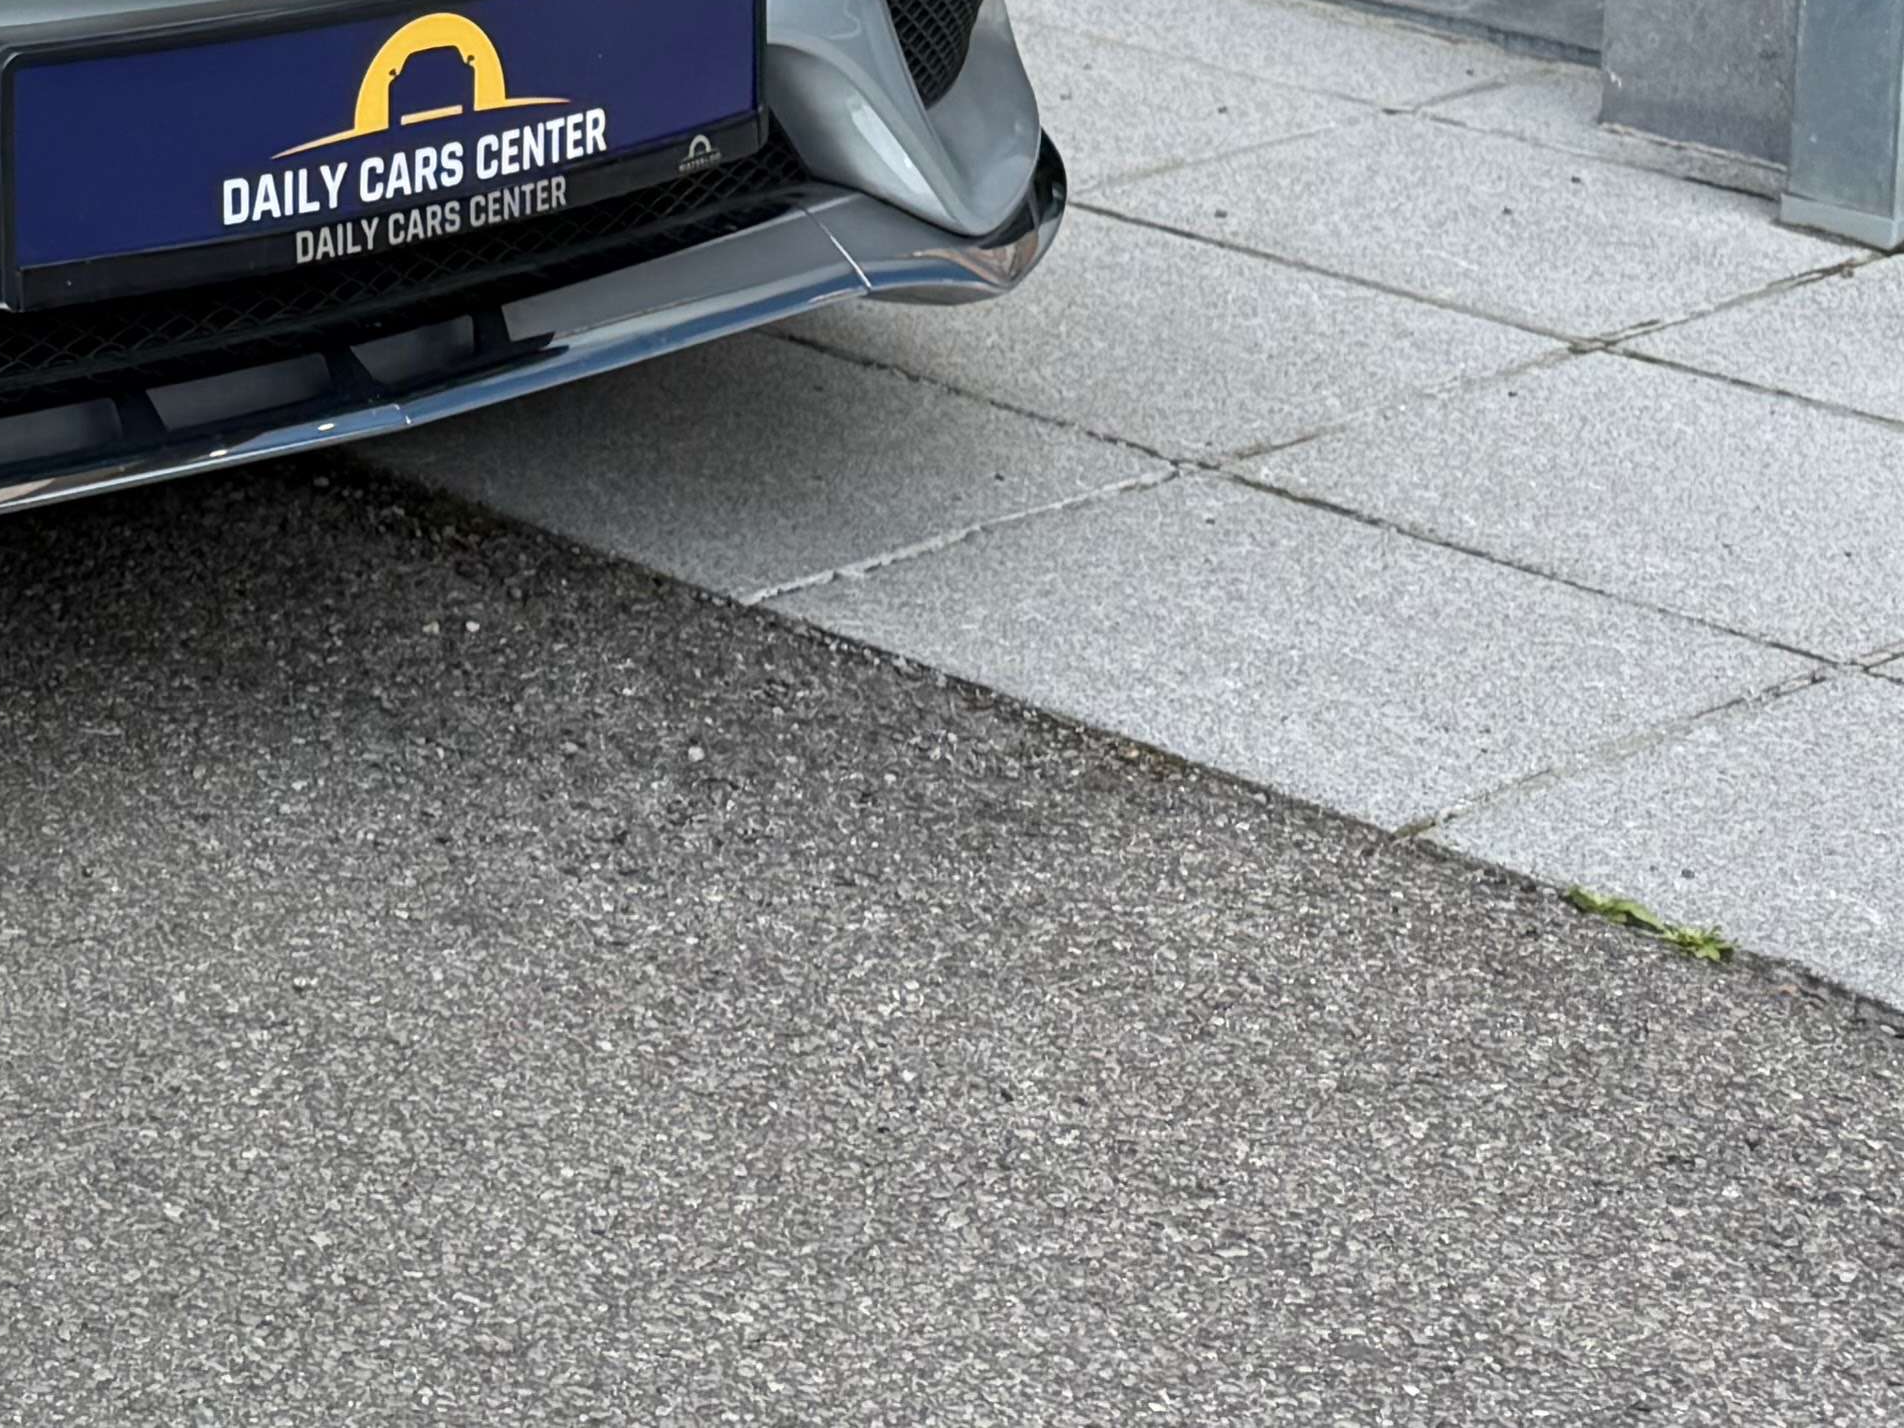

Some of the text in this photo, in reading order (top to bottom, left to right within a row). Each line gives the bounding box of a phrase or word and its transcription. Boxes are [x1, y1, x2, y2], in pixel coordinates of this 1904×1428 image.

[223, 107, 607, 226] DAILY CARS CENTER
[296, 175, 567, 265] DAILY CARS CENTER
